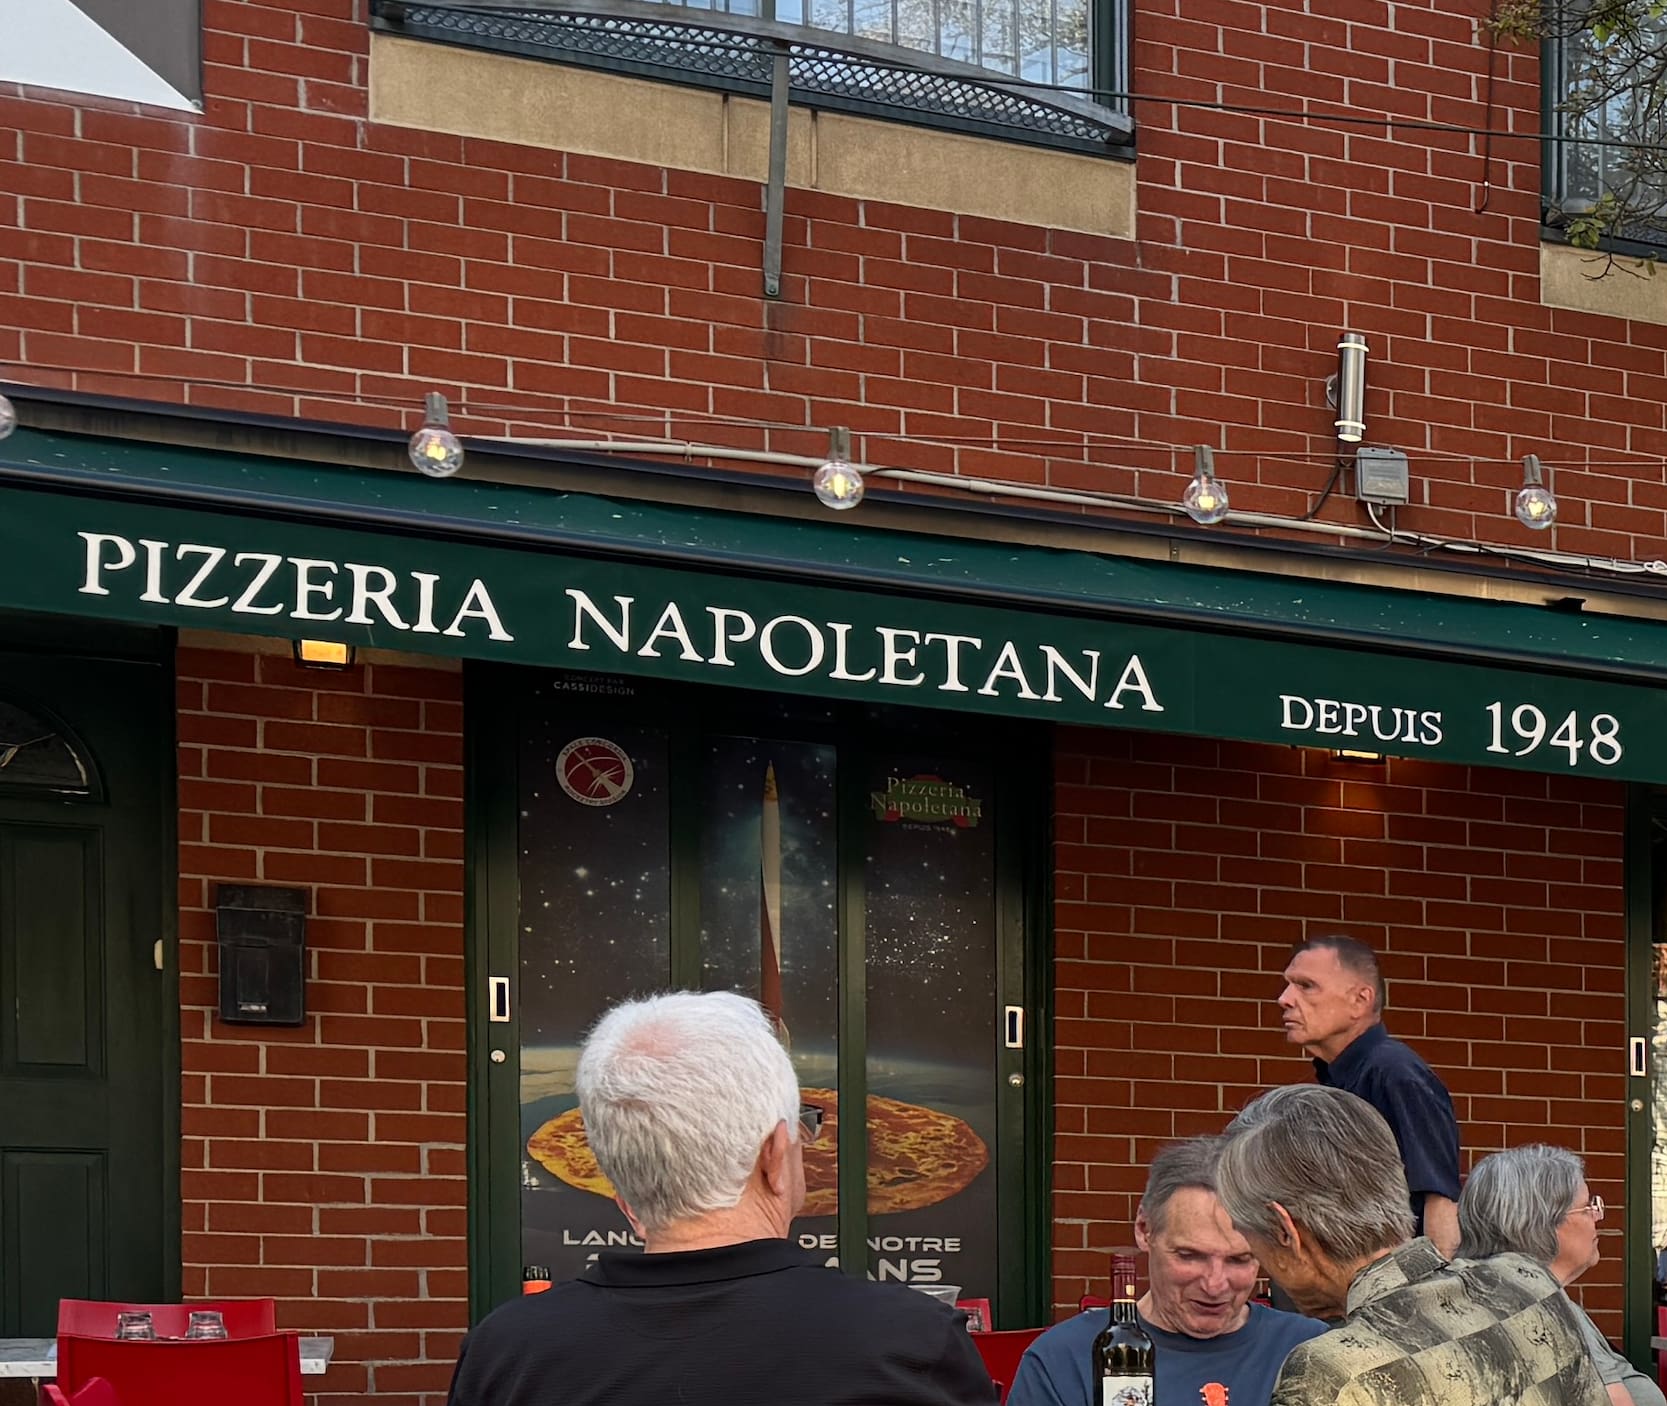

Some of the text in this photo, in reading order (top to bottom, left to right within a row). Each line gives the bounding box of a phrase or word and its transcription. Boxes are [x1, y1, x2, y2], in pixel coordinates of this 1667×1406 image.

[78, 532, 1164, 711] PIZZERIA NAPOLETANA
[1279, 695, 1621, 765] DEPUIS 1948
[887, 777, 964, 799] Pizzeria
[870, 792, 983, 818] Napoletana
[866, 1236, 961, 1252] NOTRE
